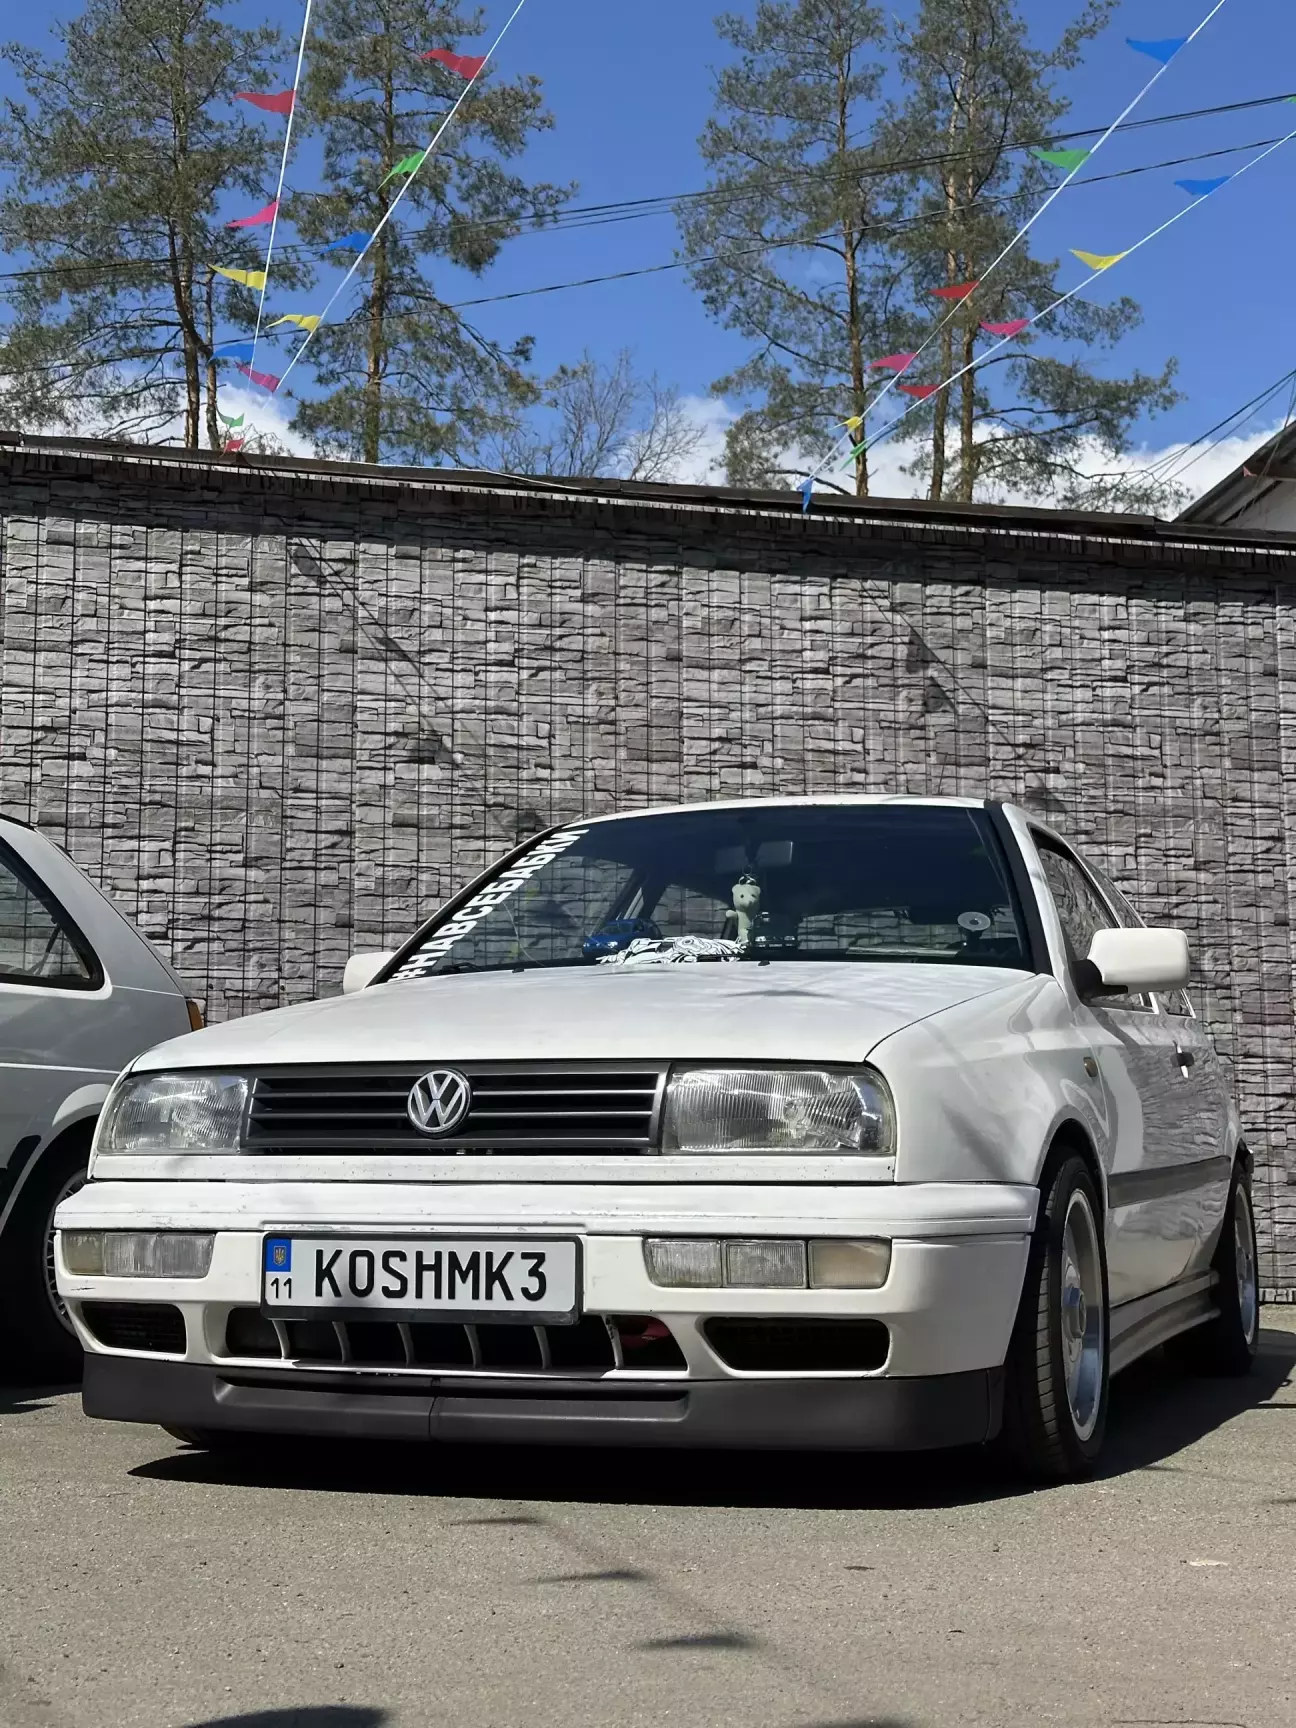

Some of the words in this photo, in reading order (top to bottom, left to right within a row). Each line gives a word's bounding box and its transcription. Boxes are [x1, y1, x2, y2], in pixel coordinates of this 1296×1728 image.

[409, 1070, 466, 1131] VW
[270, 1277, 293, 1300] 11
[314, 1249, 547, 1302] KOSHMK3
